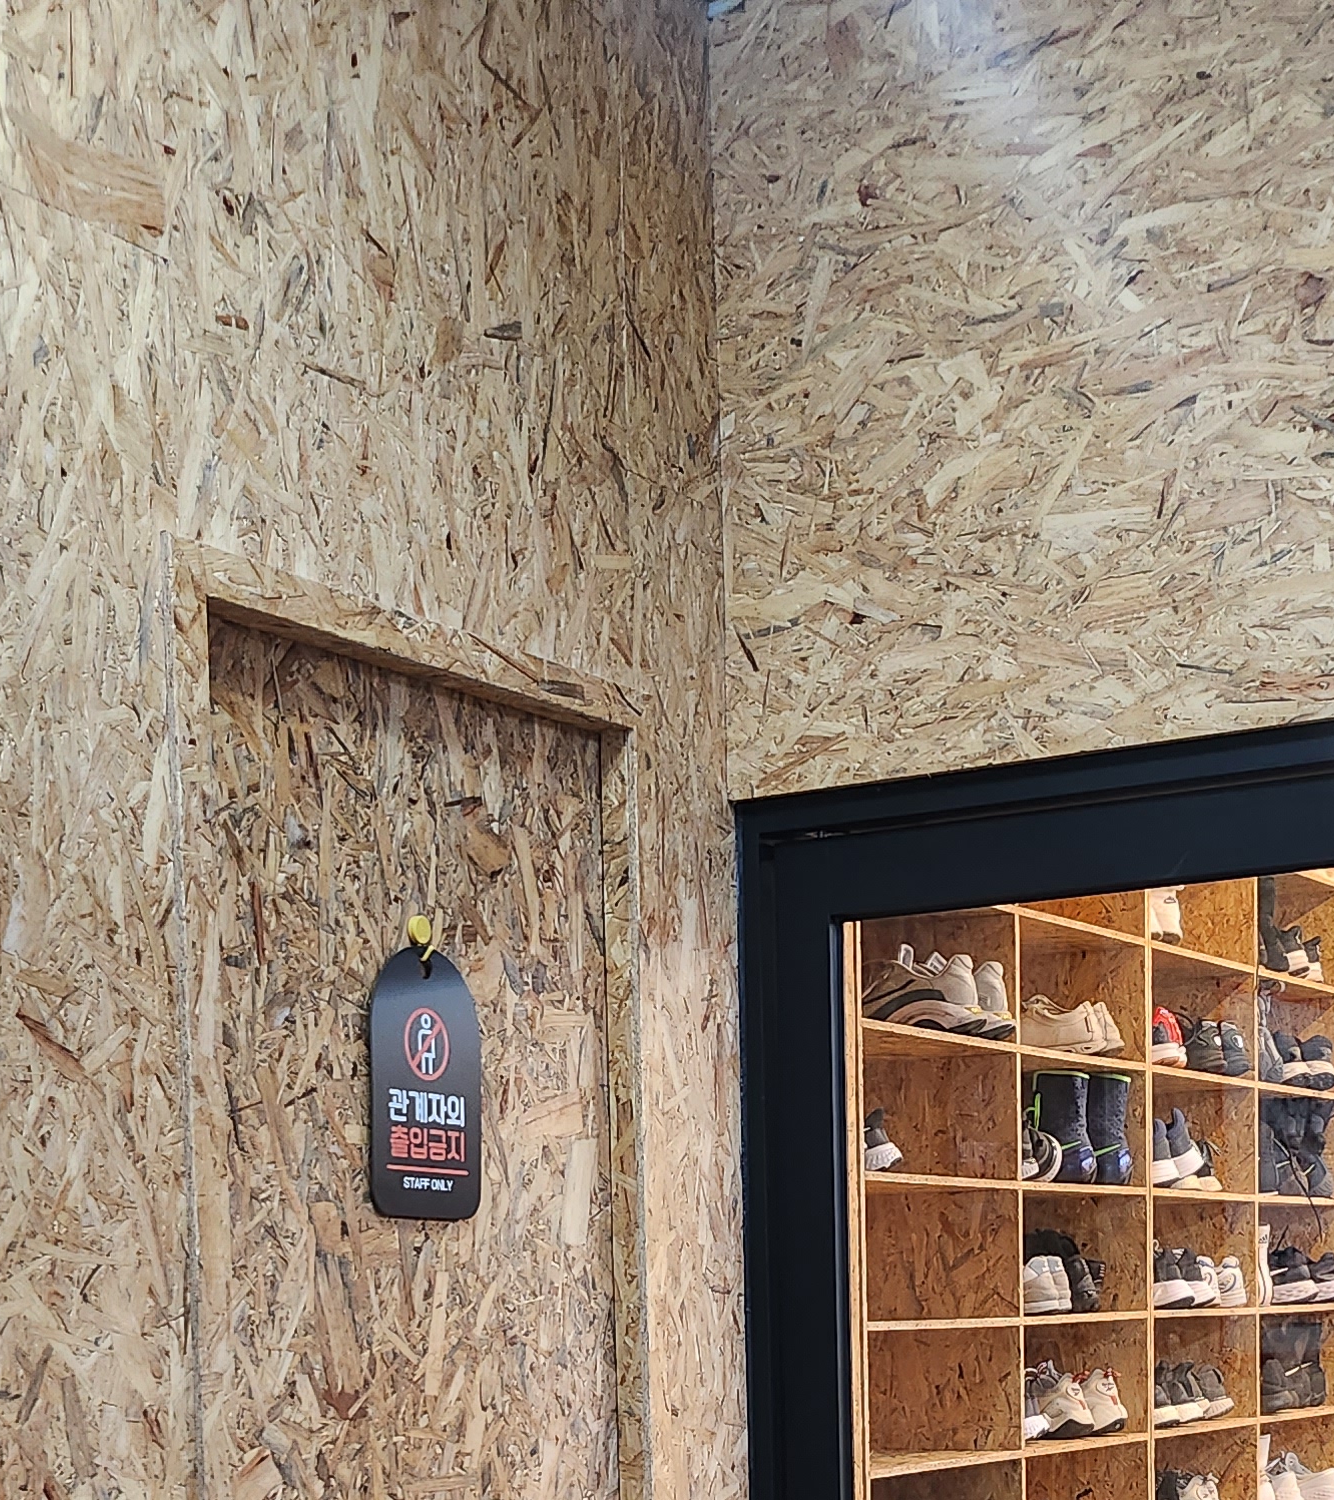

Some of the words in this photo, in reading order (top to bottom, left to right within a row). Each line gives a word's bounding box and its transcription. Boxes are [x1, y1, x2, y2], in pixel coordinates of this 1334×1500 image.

[388, 1088, 465, 1128] 관계자외
[389, 1124, 465, 1163] 출입금지
[403, 1176, 430, 1190] STAFF
[431, 1179, 454, 1192] ONLY
